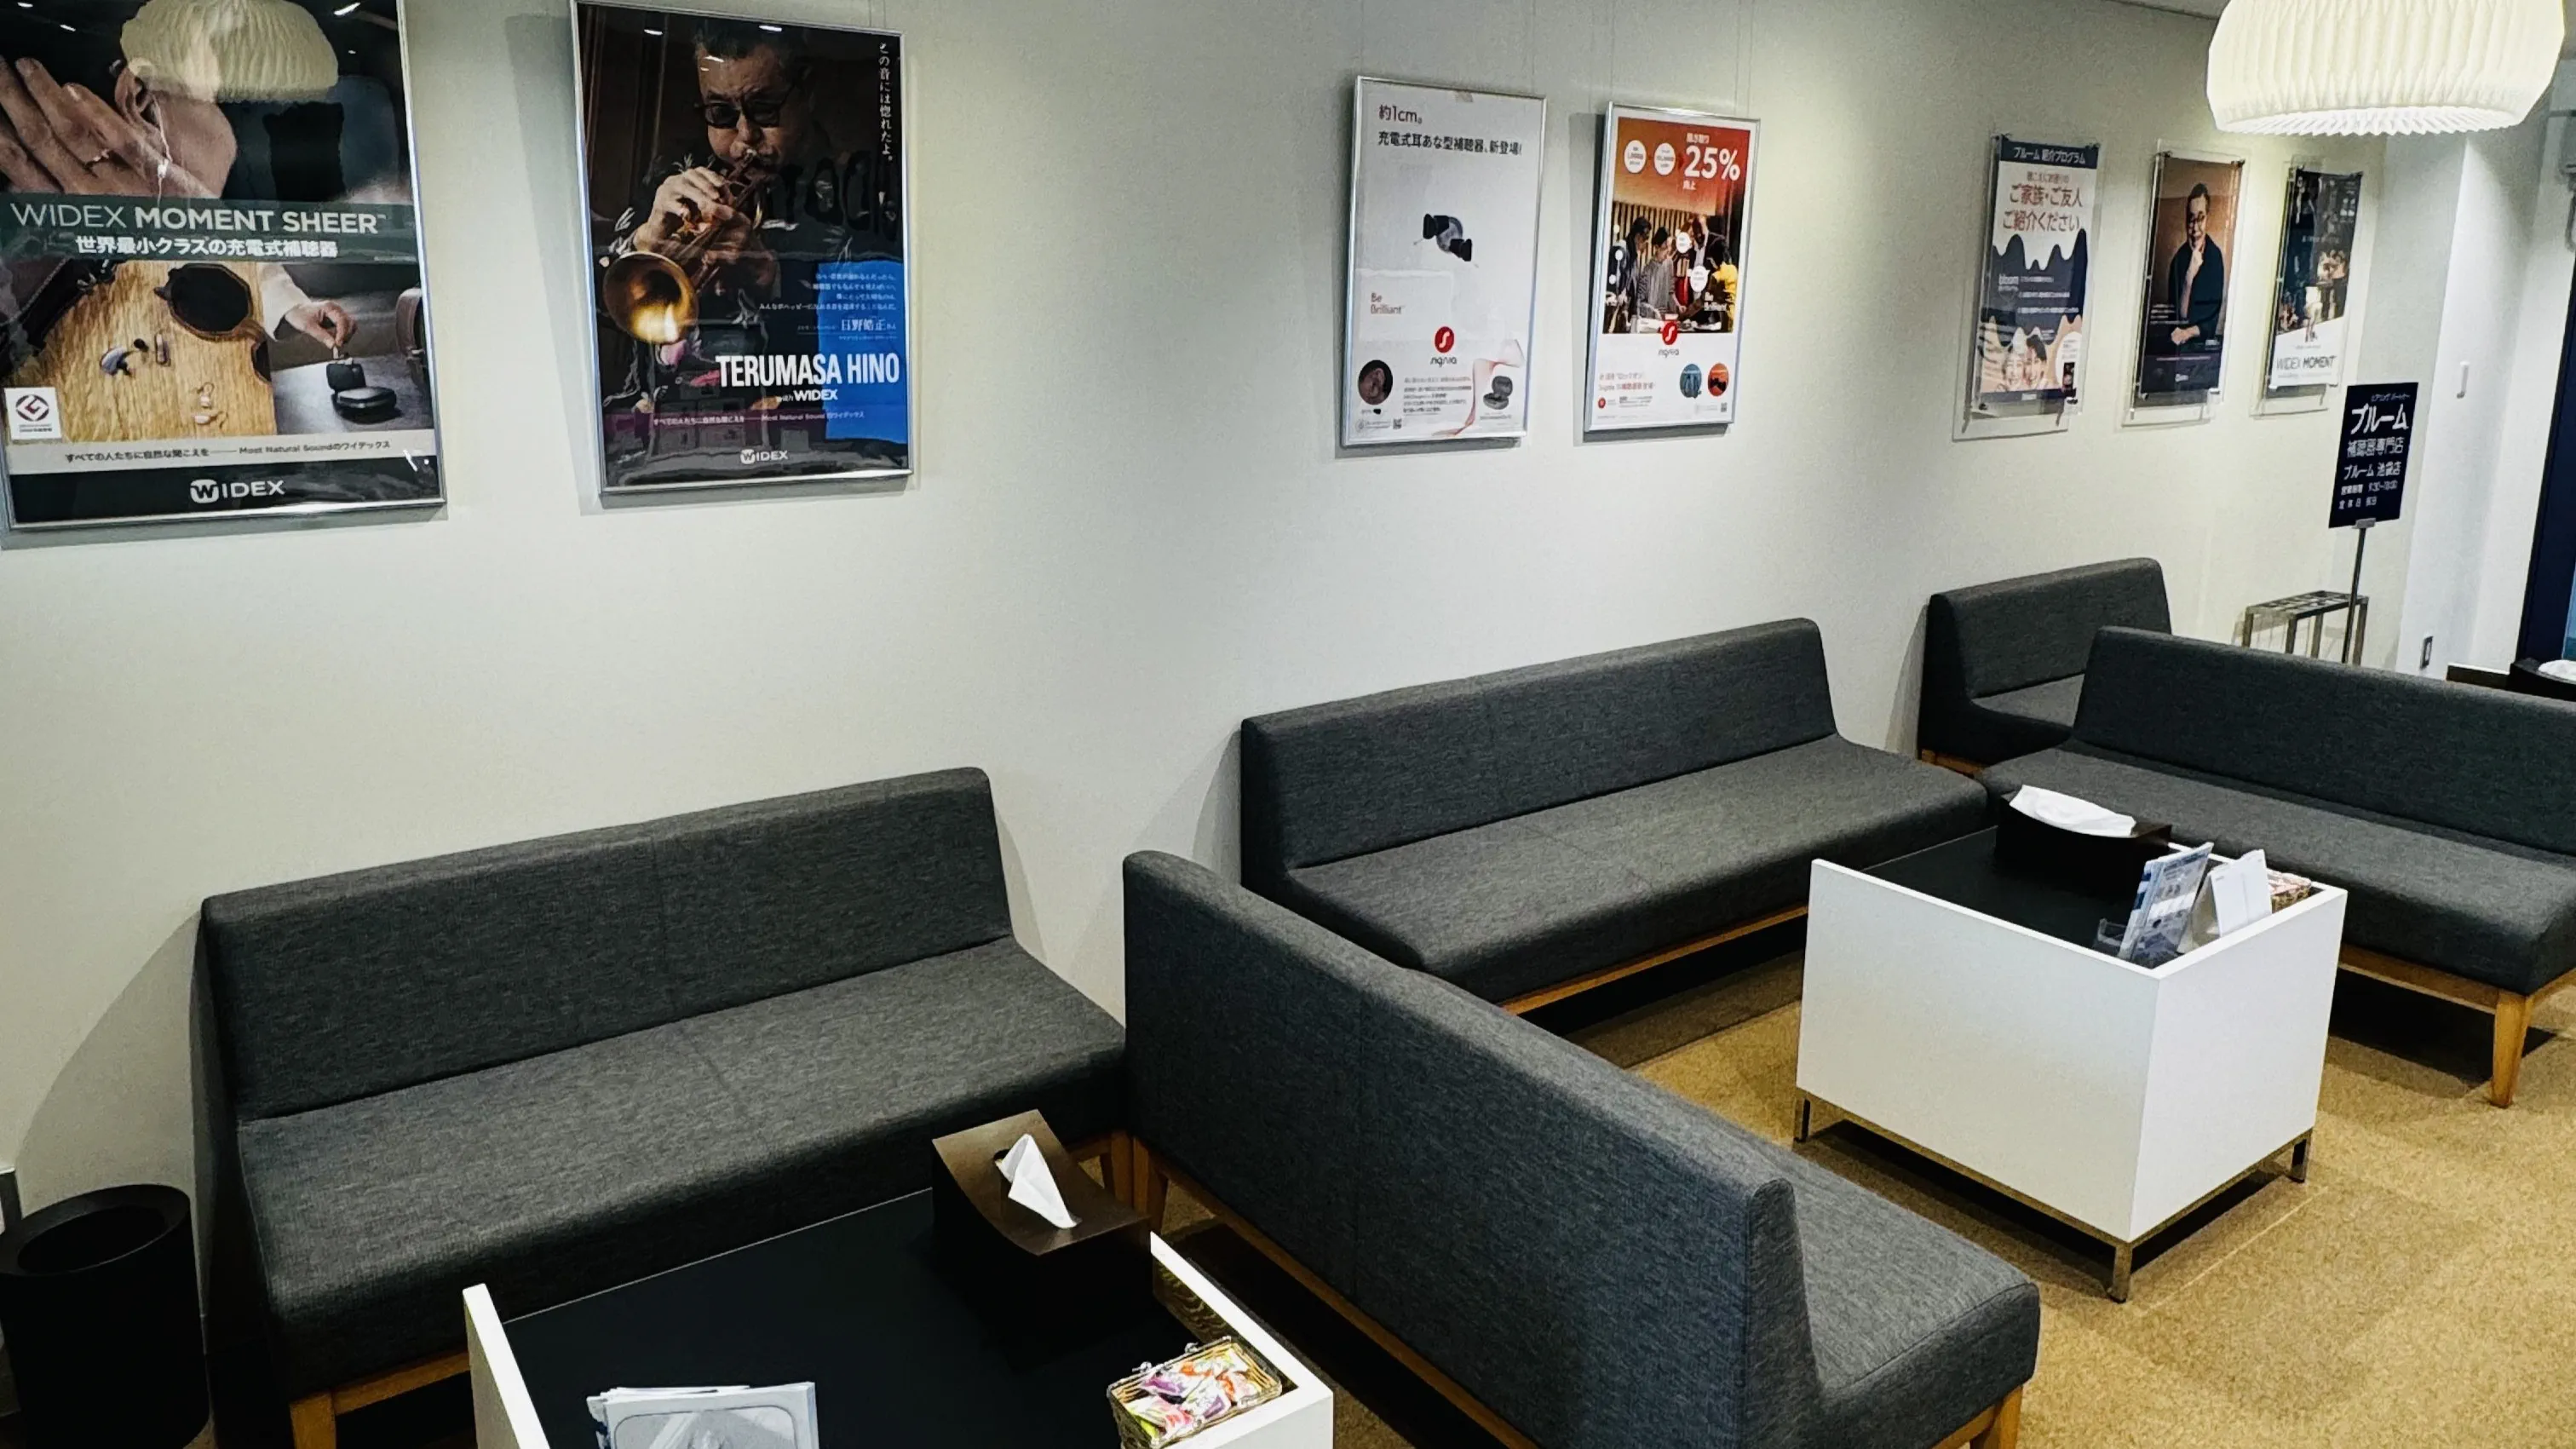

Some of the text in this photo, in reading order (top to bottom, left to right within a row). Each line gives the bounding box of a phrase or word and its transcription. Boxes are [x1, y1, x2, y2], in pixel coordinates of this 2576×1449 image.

[878, 43, 893, 162] この音には惚れたよ。
[1378, 104, 1423, 124] 約1cm。
[1684, 145, 1741, 181] 25%
[2013, 147, 2086, 164] ブルーム 紹介プログラム
[2010, 183, 2084, 207] ご家族・ご友人
[10, 203, 127, 228] WIDEX
[135, 206, 274, 232] MOMENT
[2003, 210, 2080, 232] ご紹介ください
[75, 235, 338, 258] 世界最小クラスの充電式補聴器
[715, 352, 900, 388] TERUMASA HINO
[793, 388, 838, 401] WIDEX
[2350, 403, 2409, 434] ブルーム
[740, 449, 788, 464] WIDEX
[2343, 463, 2374, 480] ブルーム
[189, 478, 286, 504] WIDEX
